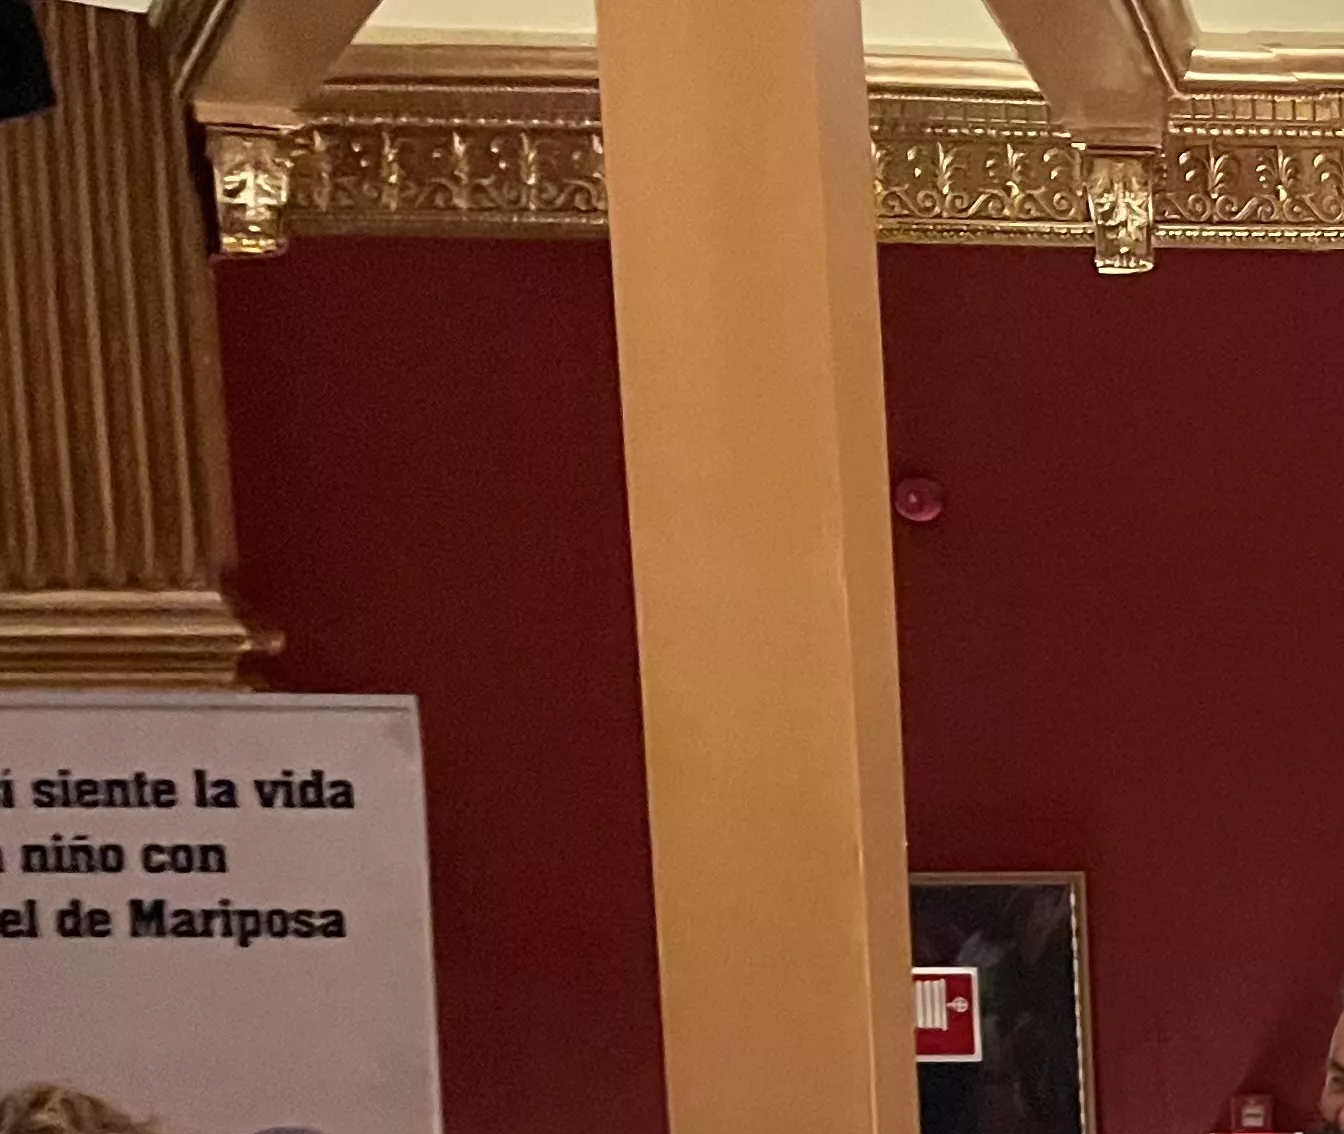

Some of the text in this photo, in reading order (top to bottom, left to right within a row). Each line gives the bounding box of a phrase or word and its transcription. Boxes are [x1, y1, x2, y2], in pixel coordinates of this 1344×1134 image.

[32, 769, 178, 808] siente
[193, 769, 239, 808] la
[254, 769, 355, 808] vida
[21, 834, 126, 873] niño
[142, 844, 228, 873] con
[57, 899, 112, 938] de
[129, 899, 347, 947] Mariposa
